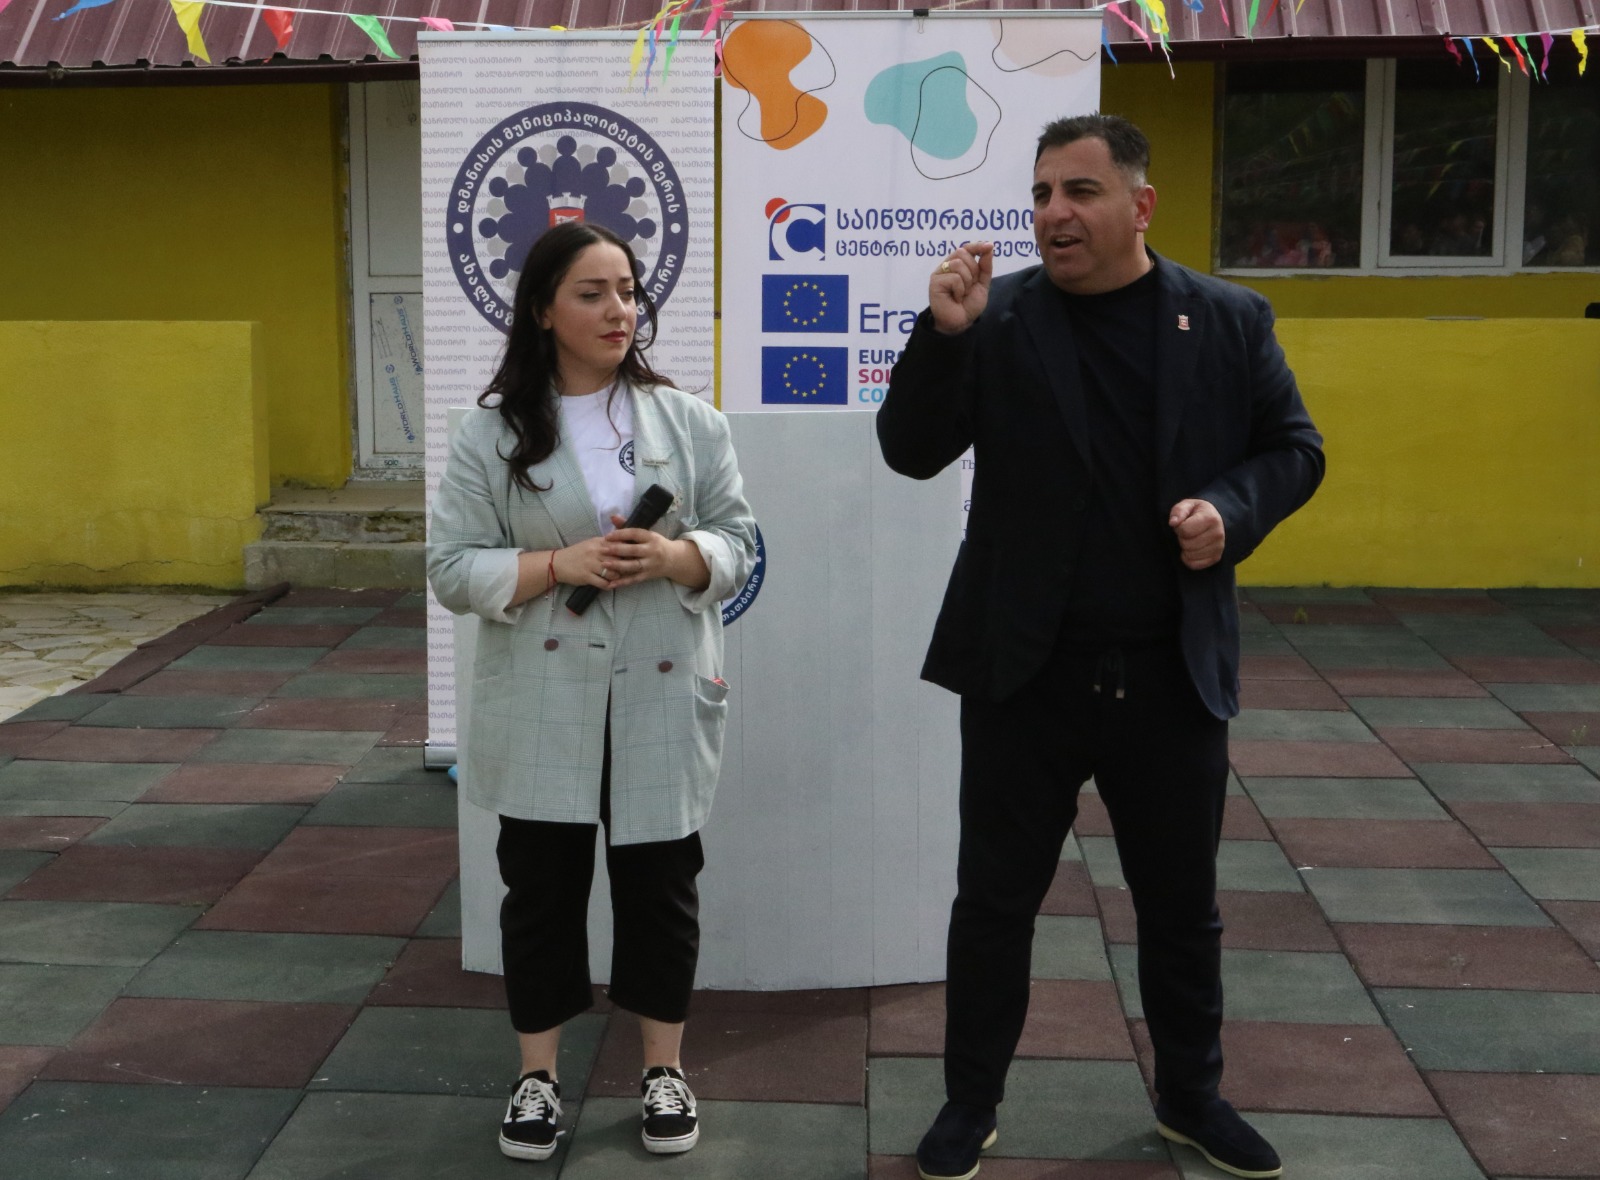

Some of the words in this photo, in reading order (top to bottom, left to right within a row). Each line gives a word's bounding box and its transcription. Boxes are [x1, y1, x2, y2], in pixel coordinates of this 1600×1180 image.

[457, 138, 504, 213] დმანისის
[503, 109, 654, 161] მუნიციპალიტეტის
[652, 160, 681, 213] მერის
[836, 240, 910, 257] ცენტრი
[916, 240, 1040, 257] საქაველ
[459, 253, 514, 327] ახალგაზ
[860, 303, 918, 334] Era
[859, 350, 904, 364] EUR
[858, 387, 888, 403] CO
[721, 574, 760, 621] თათბირო
